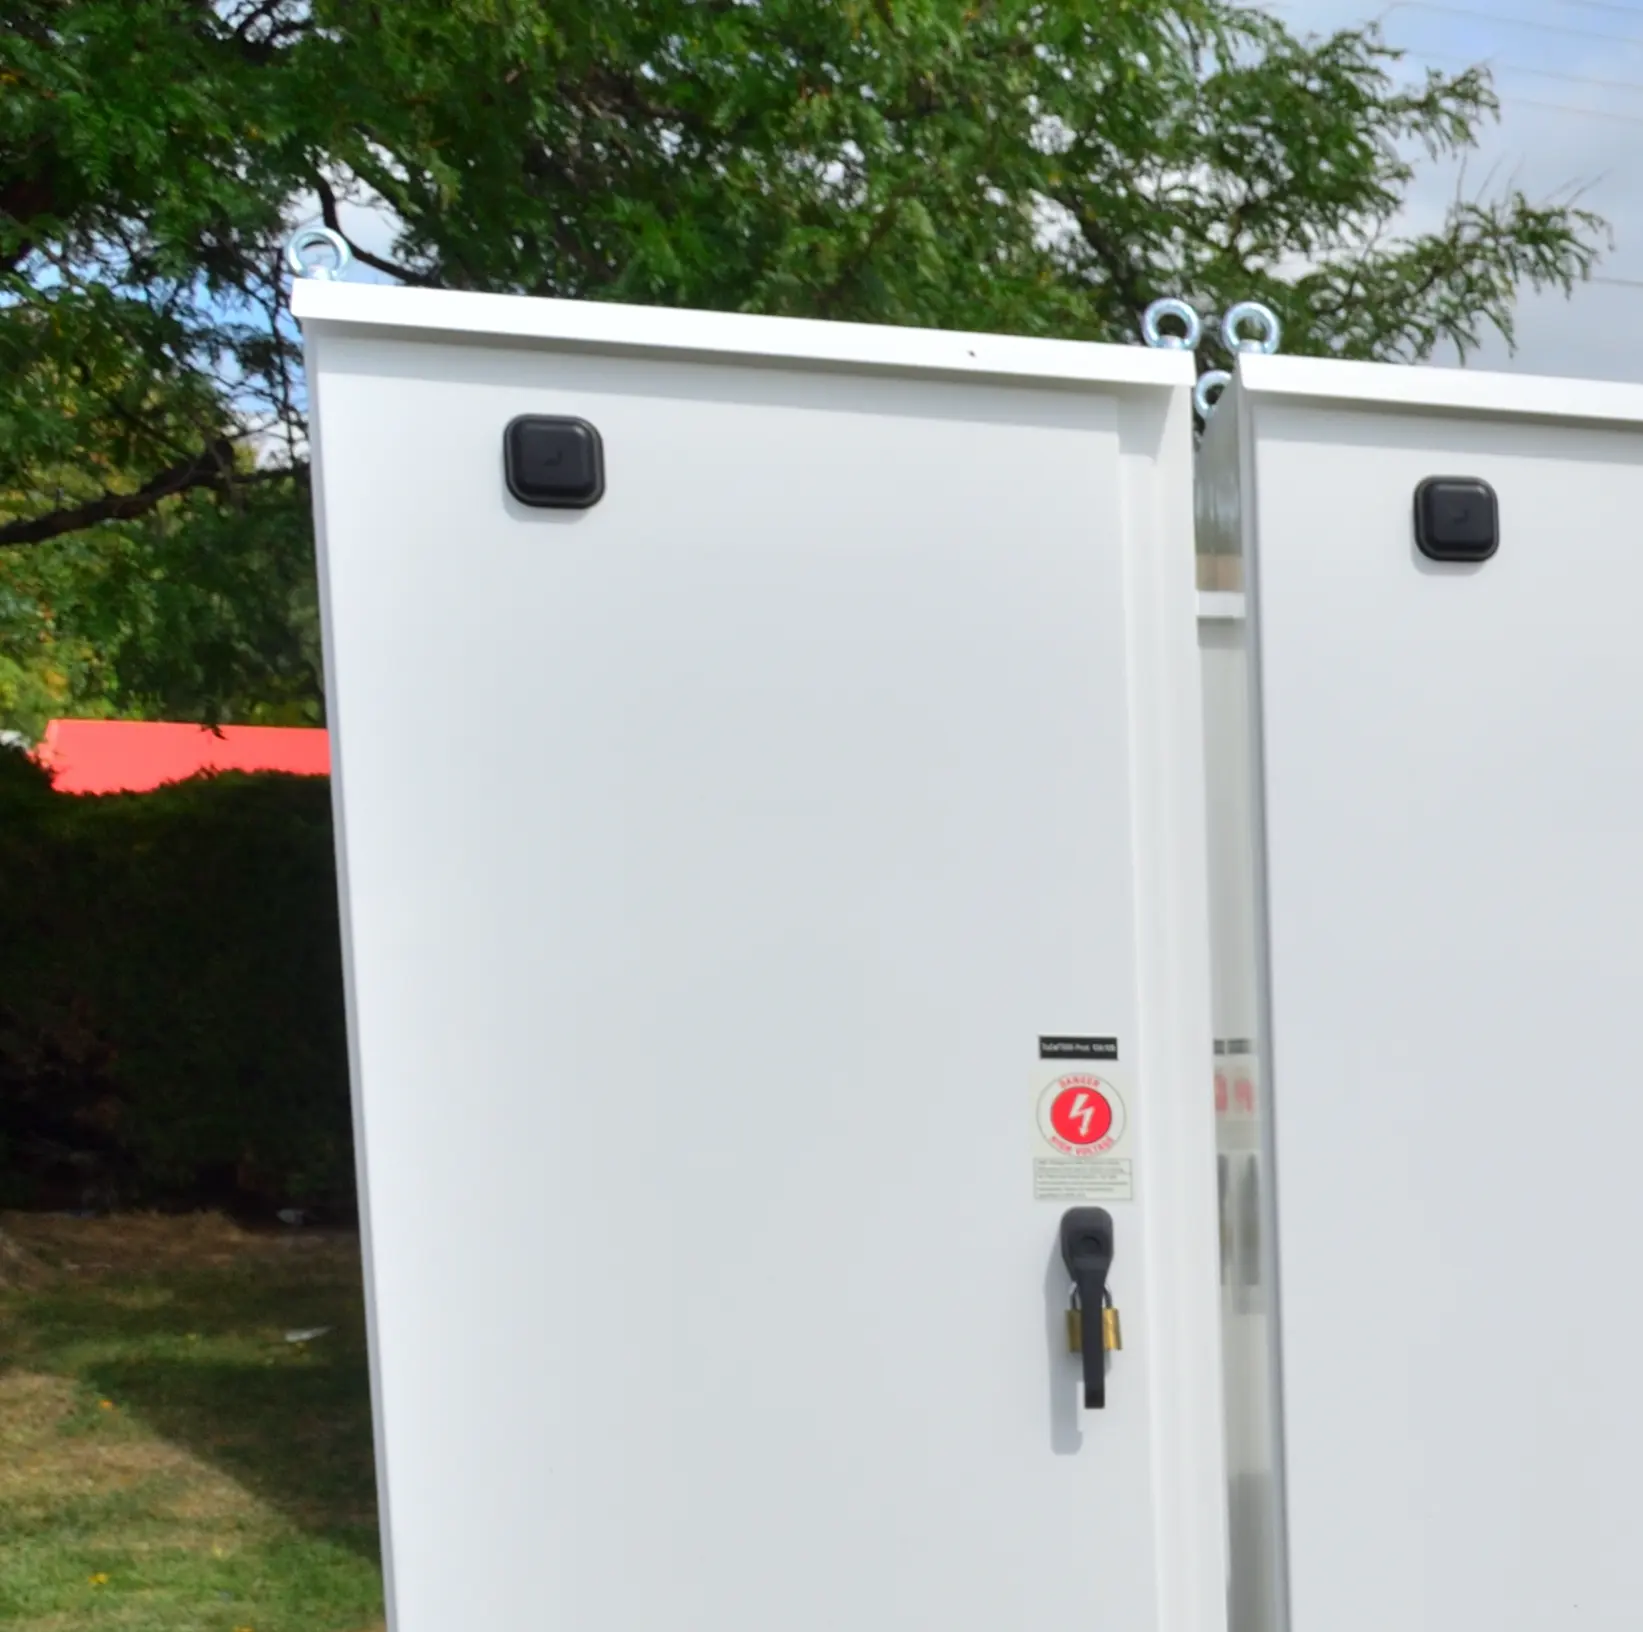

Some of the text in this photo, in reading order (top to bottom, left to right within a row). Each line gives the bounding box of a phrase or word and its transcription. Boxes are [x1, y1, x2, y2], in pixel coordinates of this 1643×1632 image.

[1059, 1075, 1100, 1088] DANGER
[1050, 1136, 1114, 1156] HIGH VOLTAGE
